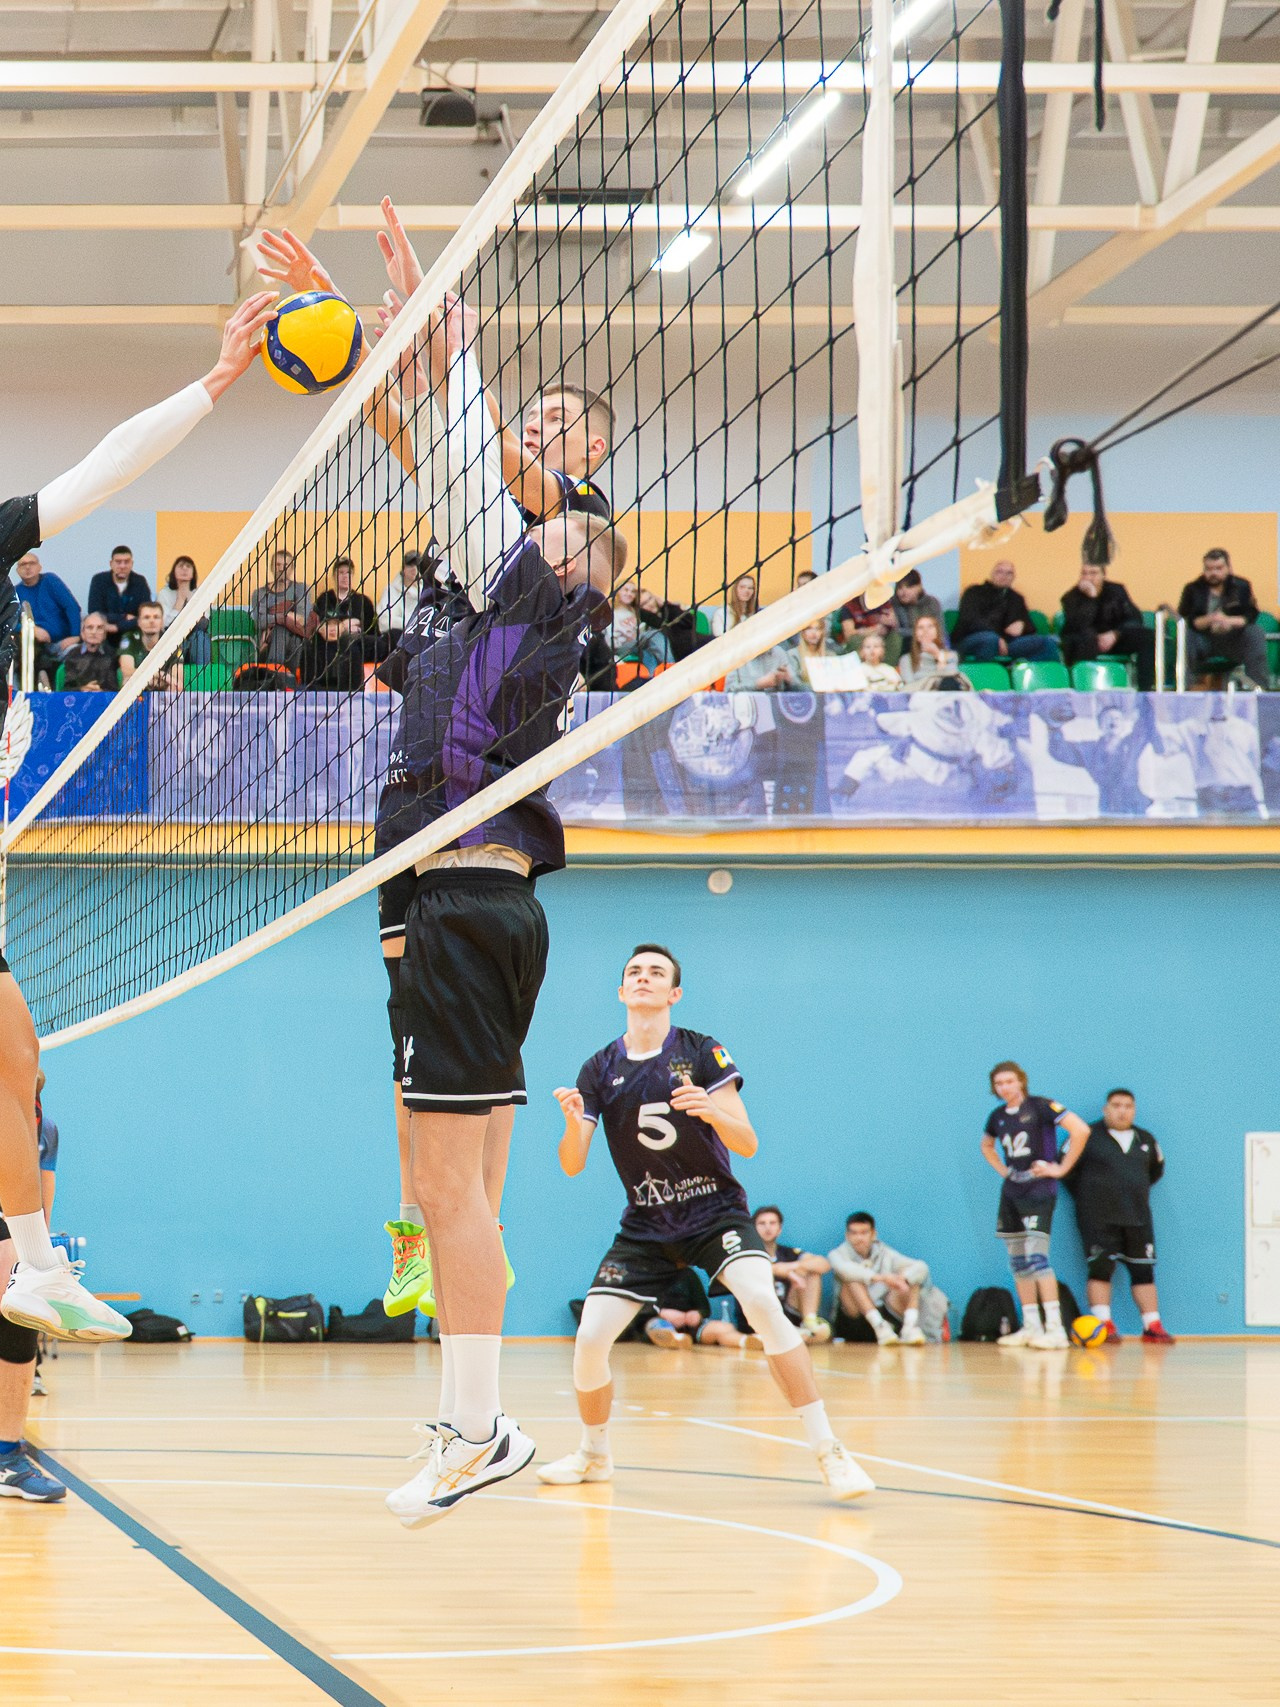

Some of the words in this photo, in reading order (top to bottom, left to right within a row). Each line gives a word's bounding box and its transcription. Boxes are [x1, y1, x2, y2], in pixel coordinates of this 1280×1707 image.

[637, 1101, 678, 1151] 5
[1002, 1131, 1031, 1158] 12
[721, 1230, 742, 1250] 5
